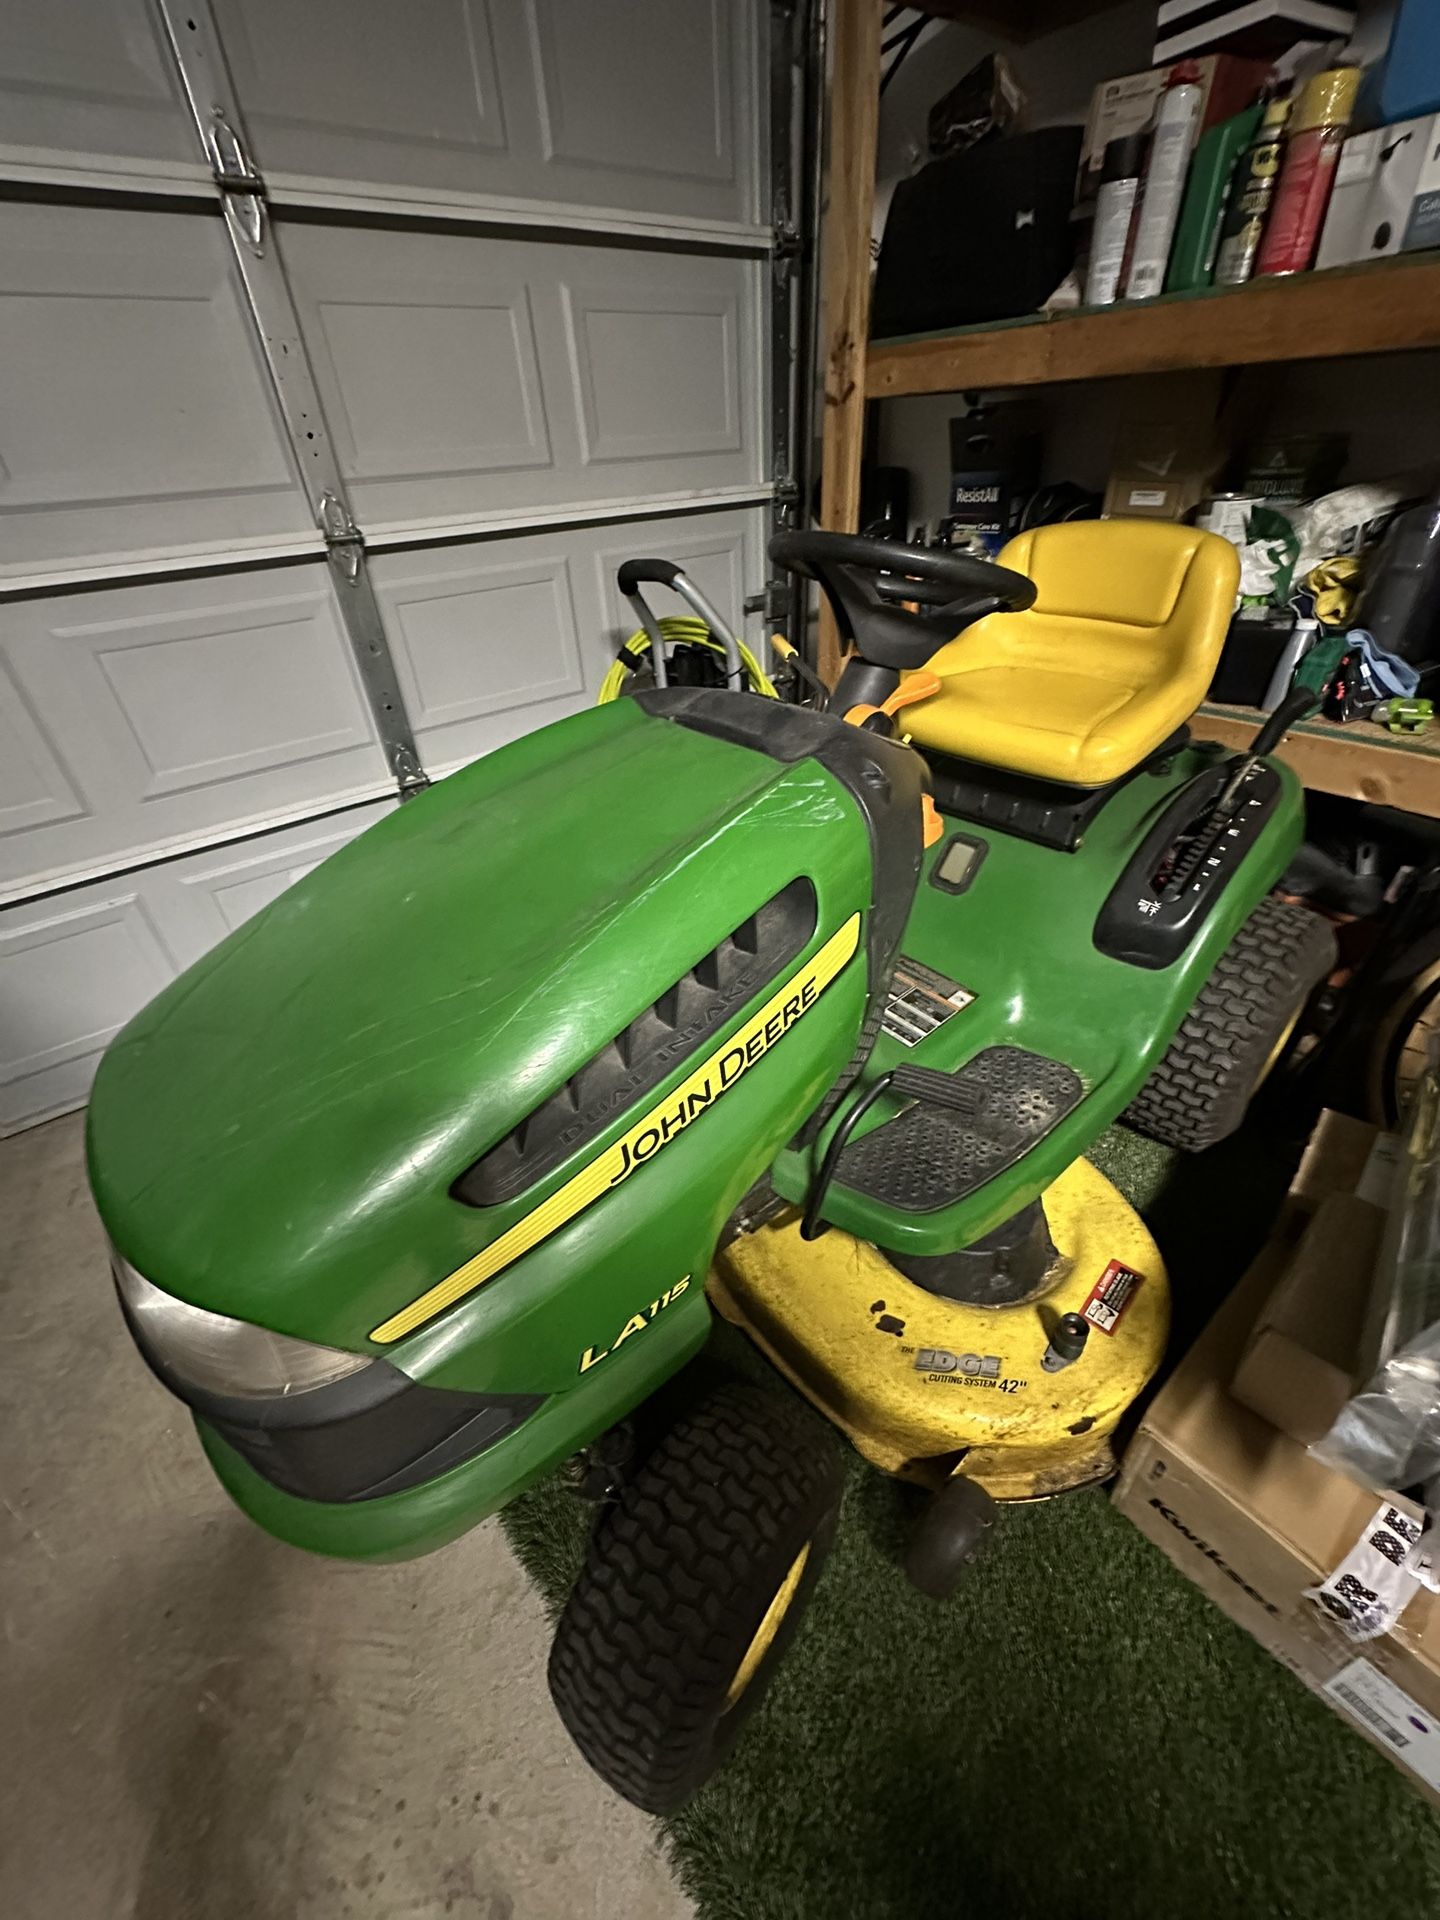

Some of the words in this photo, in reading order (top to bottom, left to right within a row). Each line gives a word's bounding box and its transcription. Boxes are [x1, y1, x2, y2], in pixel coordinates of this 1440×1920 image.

[956, 486, 1000, 503] ResistAll
[560, 1074, 642, 1145] DUAL
[655, 970, 757, 1063] INTAKE
[610, 1078, 712, 1185] JOHN
[718, 975, 817, 1089] DEERE
[914, 1348, 1002, 1379] EDGE
[928, 1373, 963, 1385] CUTTING
[963, 1377, 997, 1388] SYSTEM
[998, 1379, 1028, 1394] 42"
